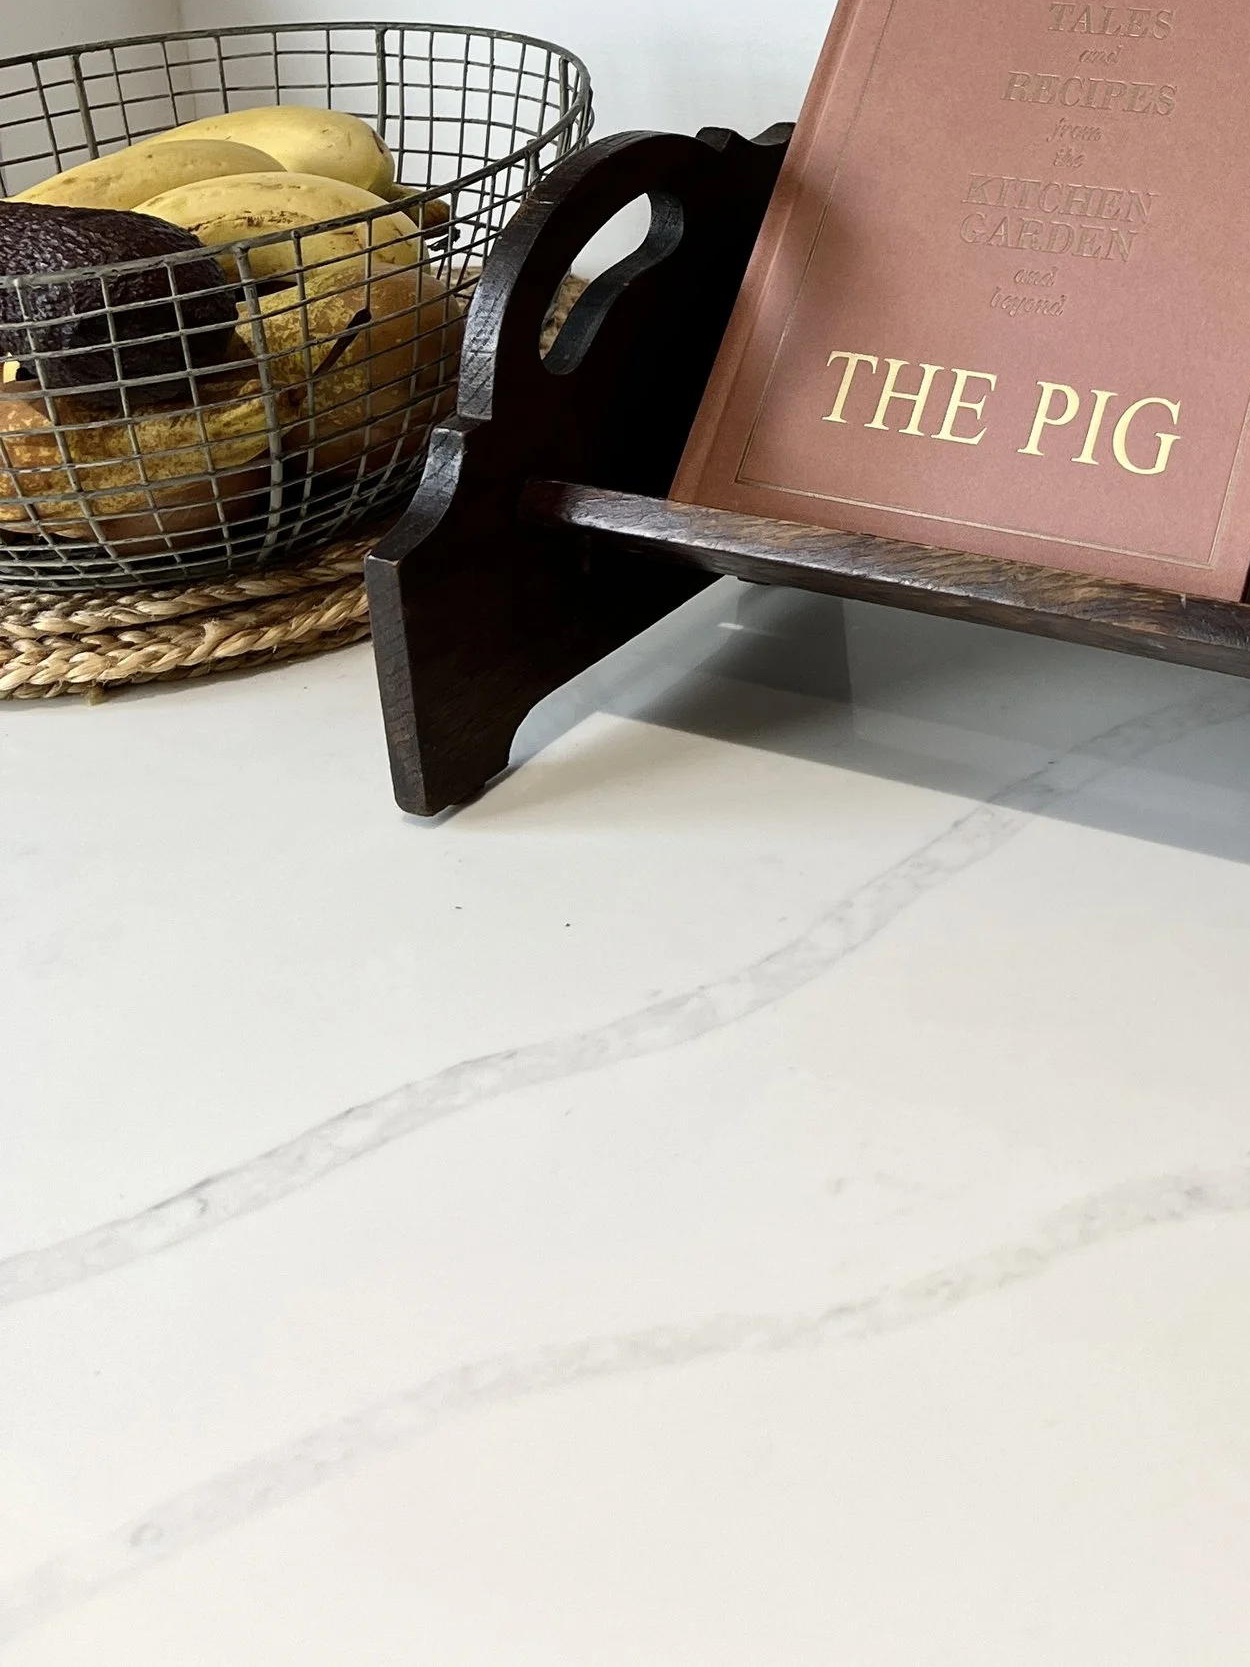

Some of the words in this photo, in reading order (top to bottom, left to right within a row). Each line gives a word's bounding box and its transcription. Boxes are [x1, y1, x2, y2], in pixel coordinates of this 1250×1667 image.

[1047, 1, 1174, 41] TALES
[1000, 70, 1178, 116] RECIPES
[960, 172, 1160, 225] KITCHEN
[959, 211, 1139, 264] GARDEN
[821, 349, 998, 447] THE
[1017, 380, 1183, 476] PIG
